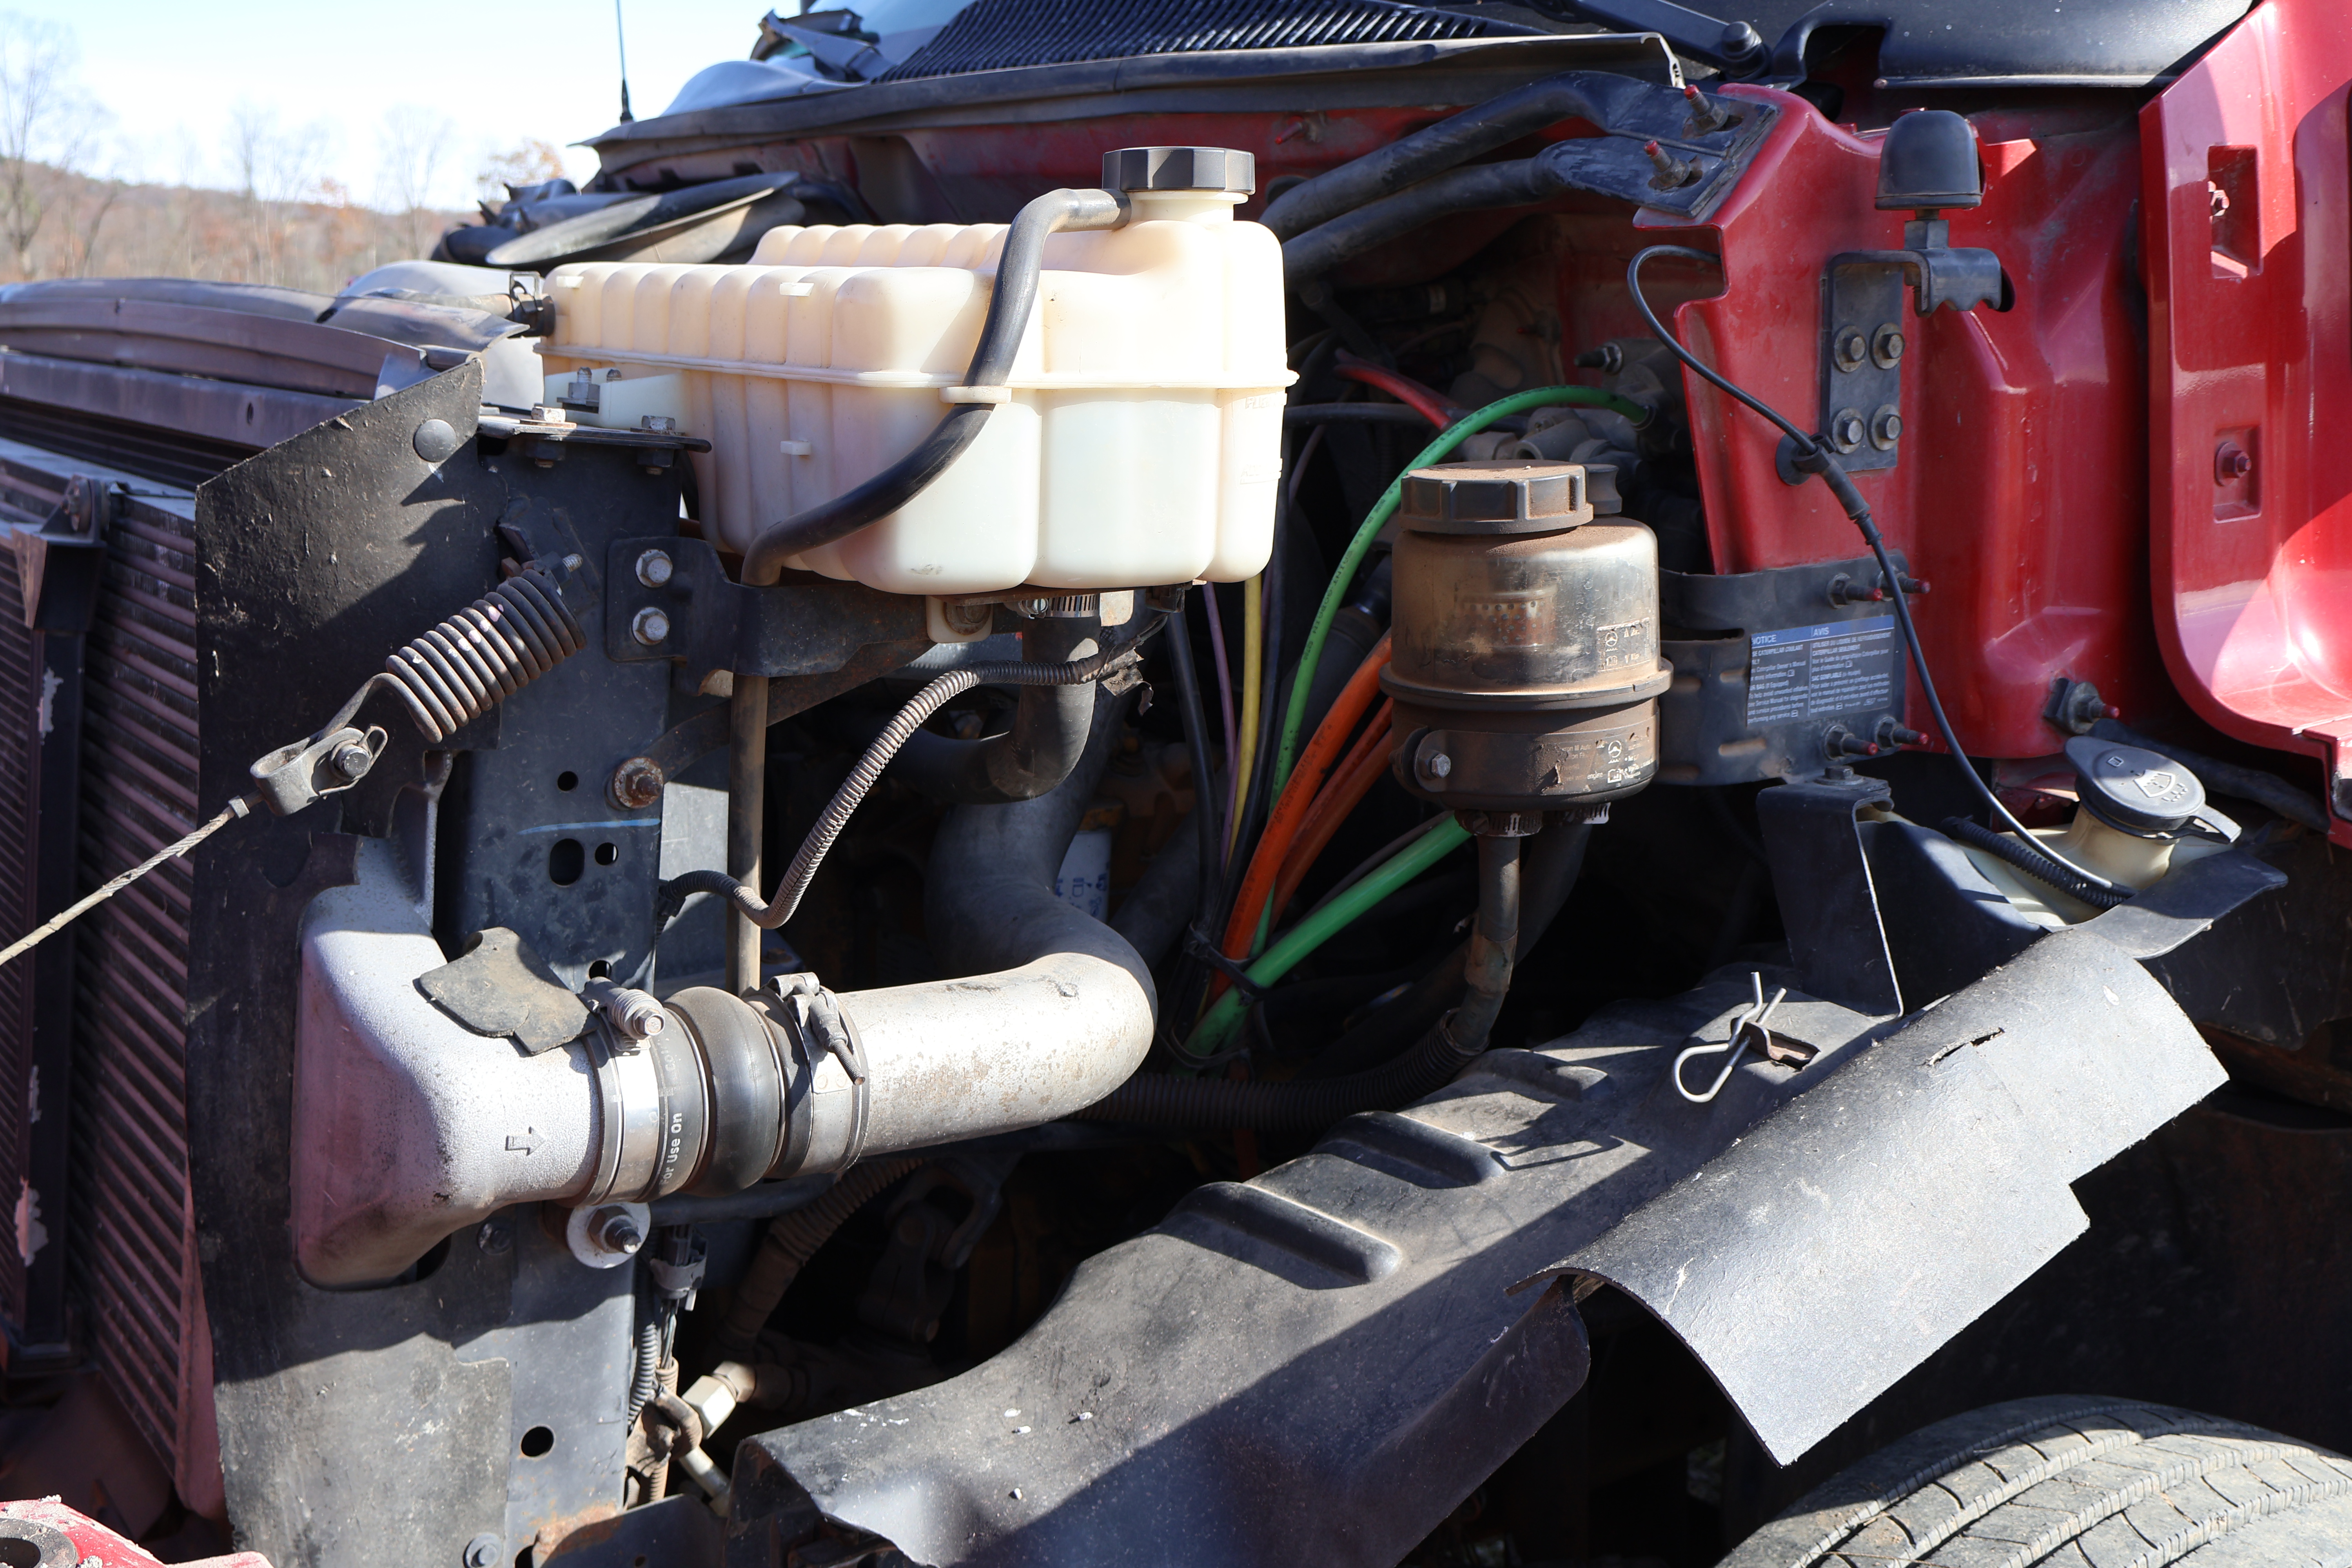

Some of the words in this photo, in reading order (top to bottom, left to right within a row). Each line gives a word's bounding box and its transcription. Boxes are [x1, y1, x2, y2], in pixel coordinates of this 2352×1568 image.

[1752, 635, 1777, 644] NOTICE
[1813, 627, 1829, 636] AVIS
[671, 1112, 682, 1134] On
[667, 1138, 681, 1164] Use
[659, 1167, 675, 1185] For
